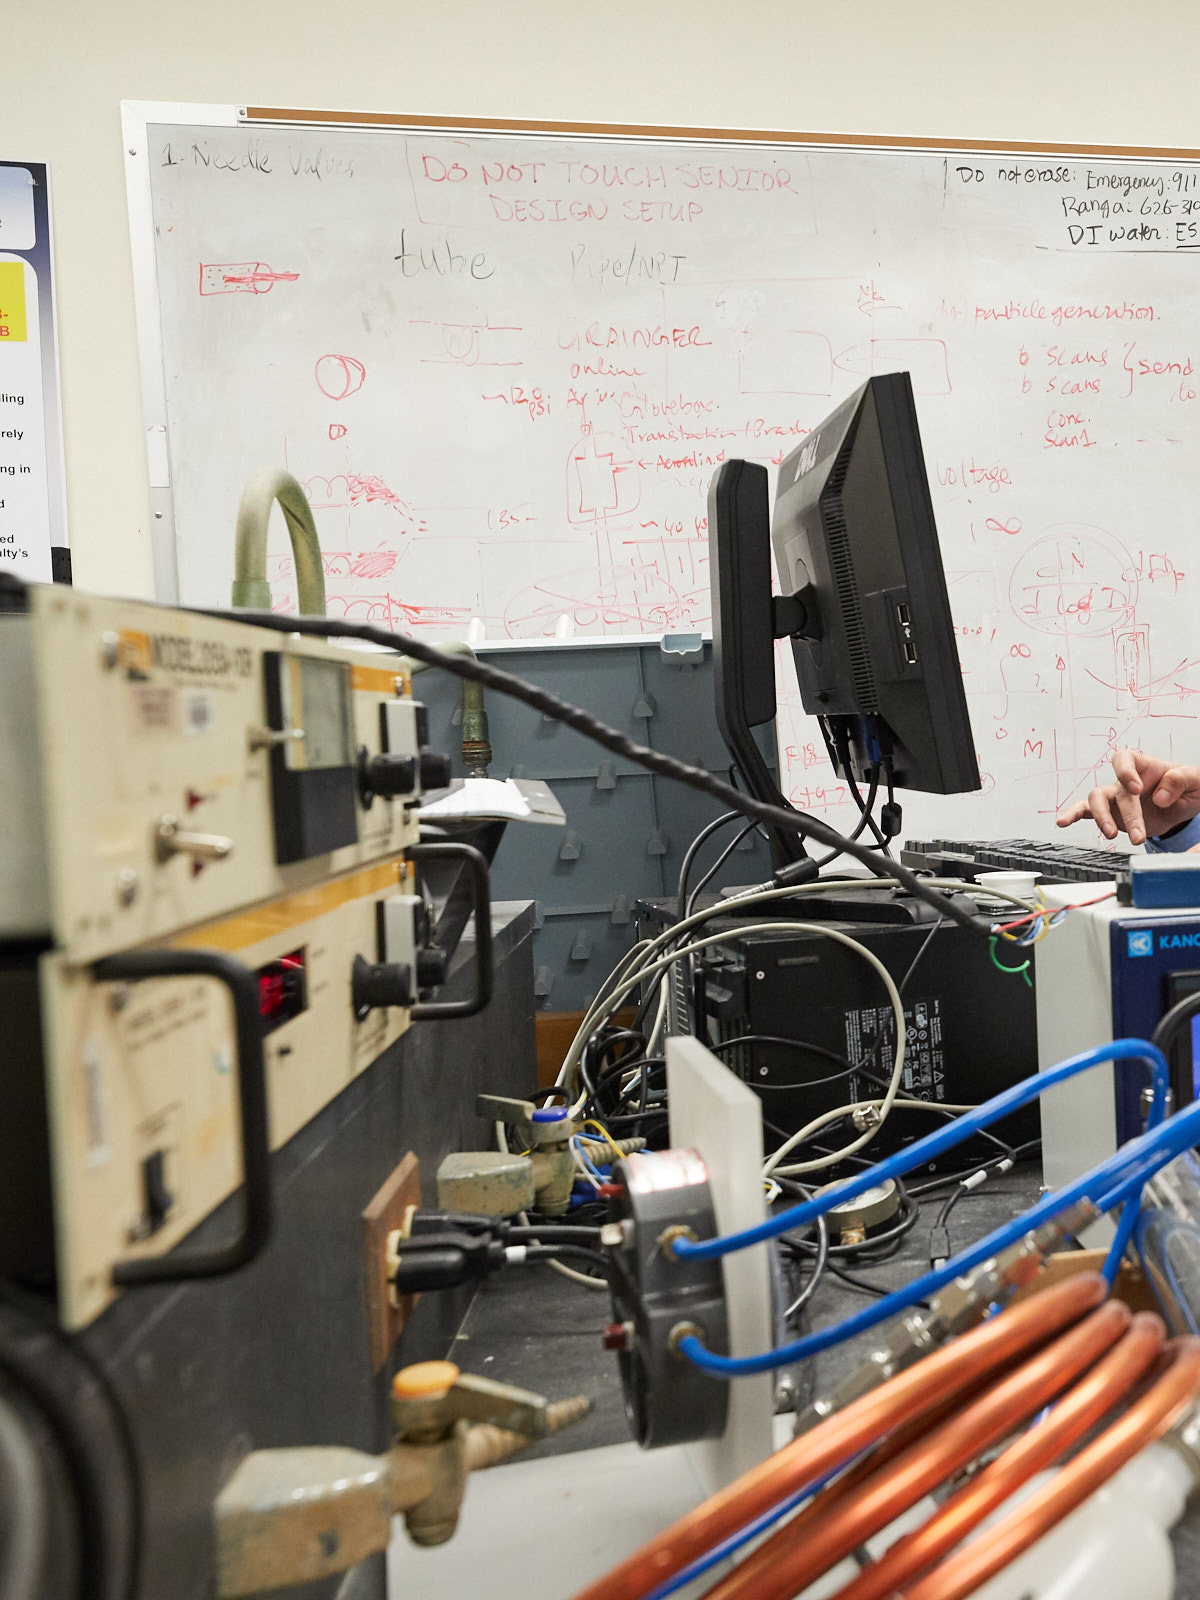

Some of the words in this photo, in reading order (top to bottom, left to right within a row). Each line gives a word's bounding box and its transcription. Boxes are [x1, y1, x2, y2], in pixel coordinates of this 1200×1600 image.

[191, 139, 273, 174] Needle
[421, 152, 468, 183] DO
[480, 161, 546, 187] NOT
[557, 160, 666, 190] TOUCH
[674, 162, 799, 194] SENIOR
[955, 166, 985, 184] Do
[489, 193, 609, 223] DESIGN
[623, 199, 704, 223] SETUP
[394, 228, 496, 280] tube
[557, 322, 713, 351] GRAINGER
[1138, 356, 1195, 377] send
[0, 393, 24, 406] ling
[19, 464, 31, 474] in
